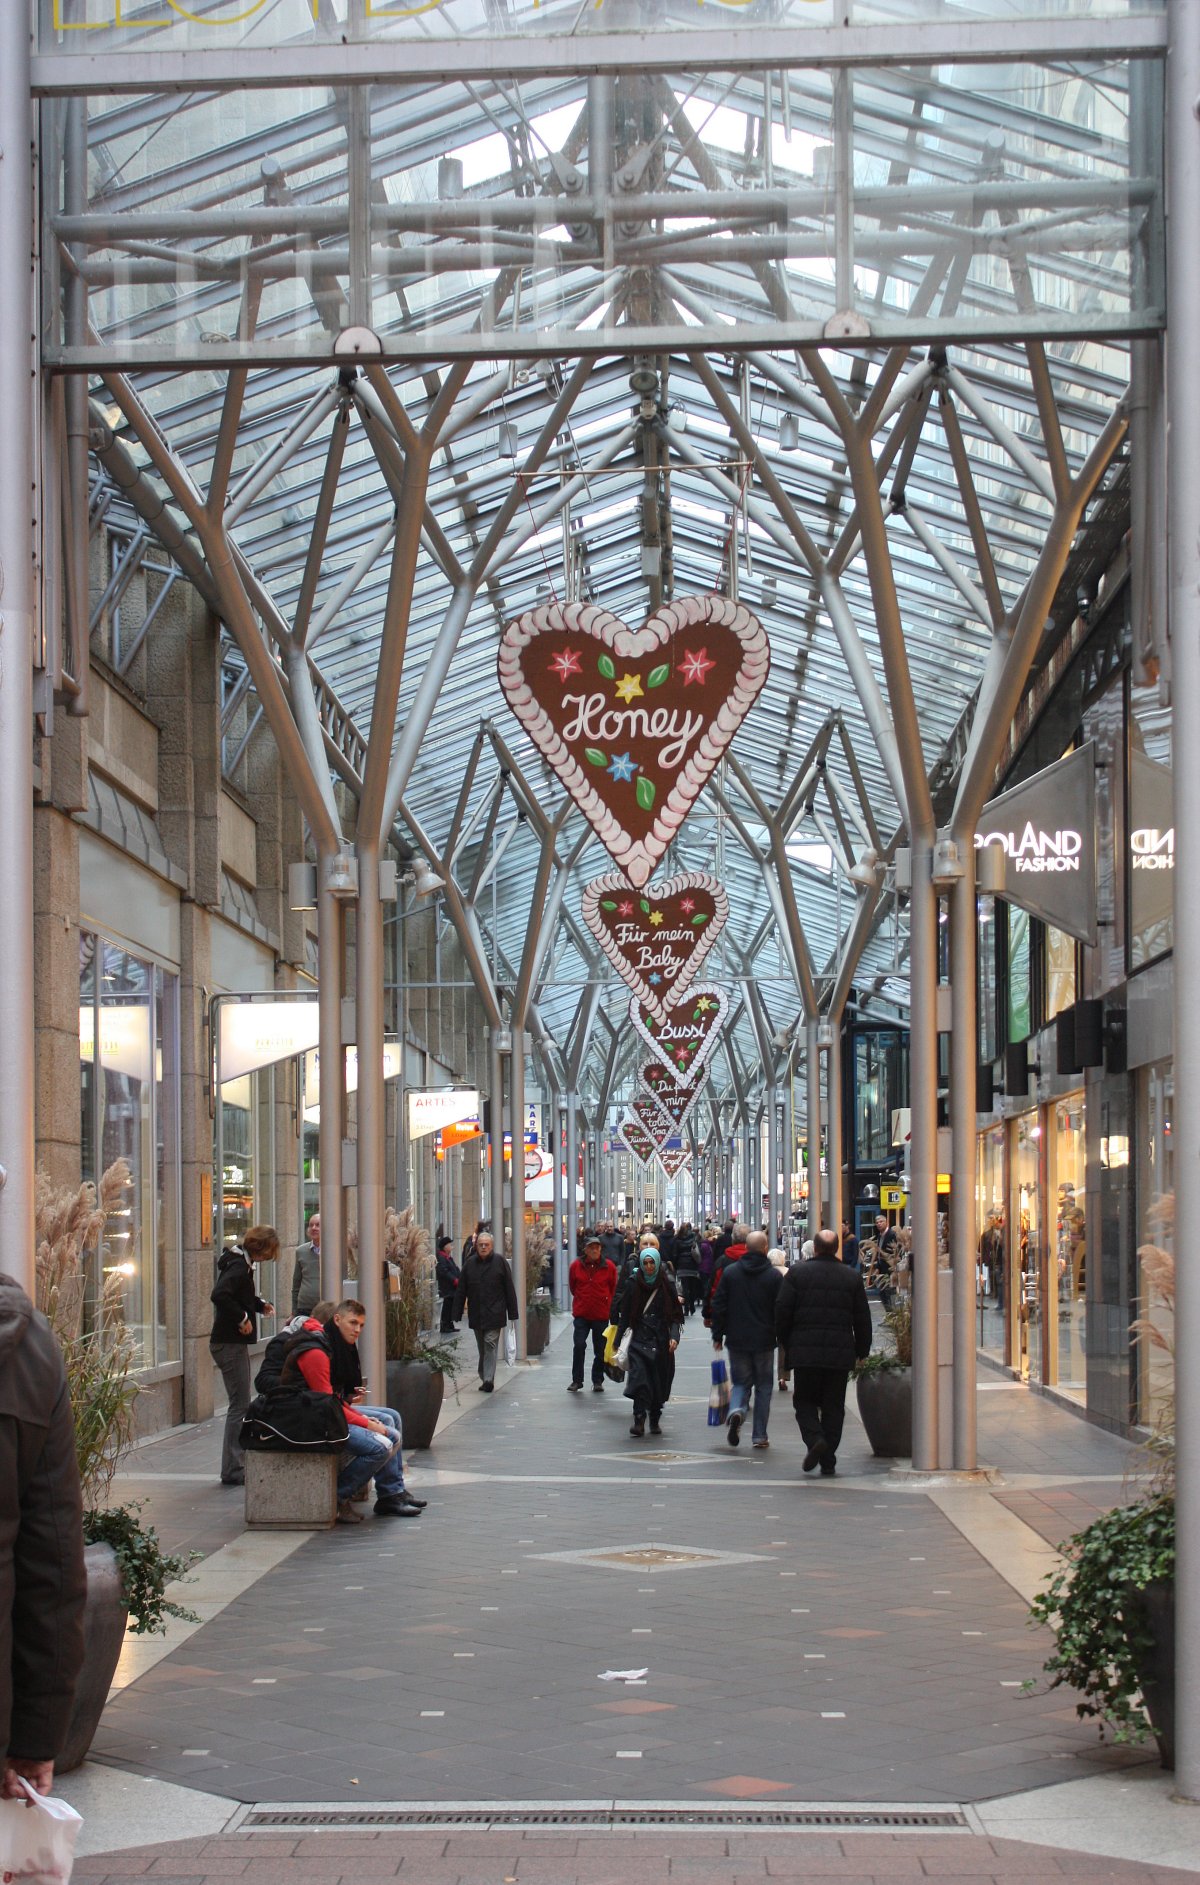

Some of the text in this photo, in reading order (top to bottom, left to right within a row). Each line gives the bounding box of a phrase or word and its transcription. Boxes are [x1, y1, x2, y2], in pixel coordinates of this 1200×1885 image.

[561, 692, 703, 769] Honey
[1015, 856, 1080, 873] FASHION
[615, 923, 695, 945] Für mein
[634, 944, 685, 978] Baby
[656, 1080, 673, 1094] Du
[415, 1097, 457, 1107] ARTES
[664, 1094, 688, 1107] mir
